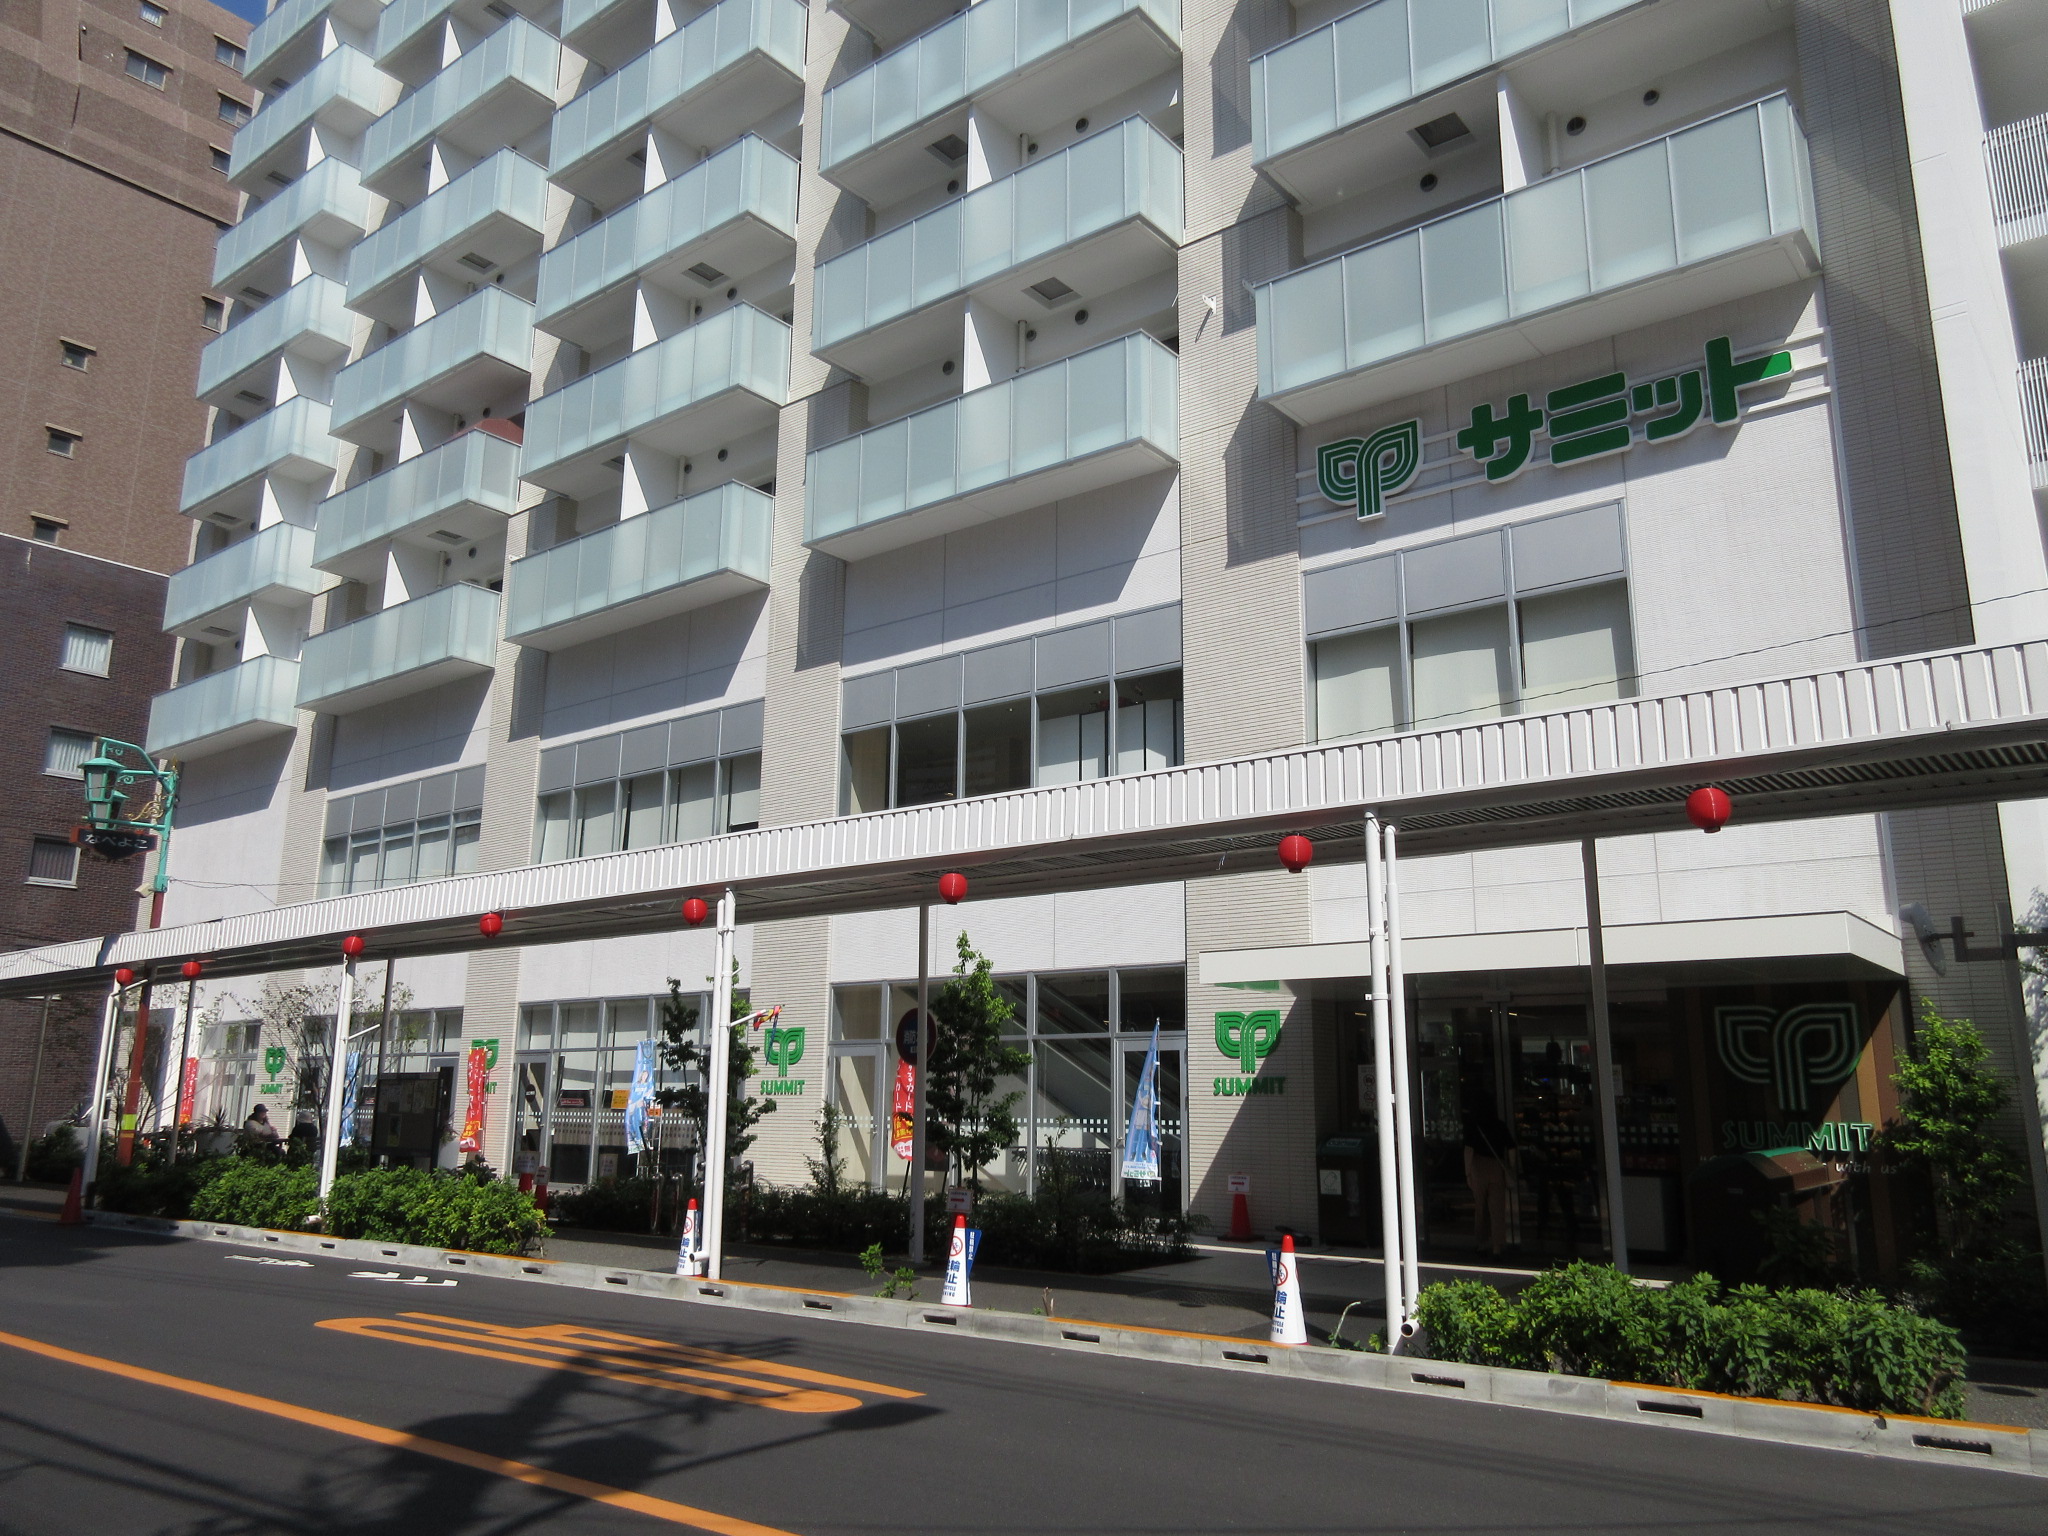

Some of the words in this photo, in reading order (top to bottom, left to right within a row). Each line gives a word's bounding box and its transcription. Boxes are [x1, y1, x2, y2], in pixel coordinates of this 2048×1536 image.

[1456, 336, 1794, 485] サミット
[85, 833, 148, 849] なべよこ
[760, 1079, 806, 1096] SUMMIT
[1213, 1077, 1287, 1097] SUMMIT
[1721, 1120, 1875, 1153] SUMMIT
[1835, 1160, 1871, 1174] with
[681, 1237, 690, 1248] 輪
[679, 1248, 688, 1258] 止
[946, 1260, 961, 1273] 輪
[944, 1272, 957, 1284] 止
[1276, 1290, 1288, 1305] 輪
[1274, 1305, 1285, 1319] 止
